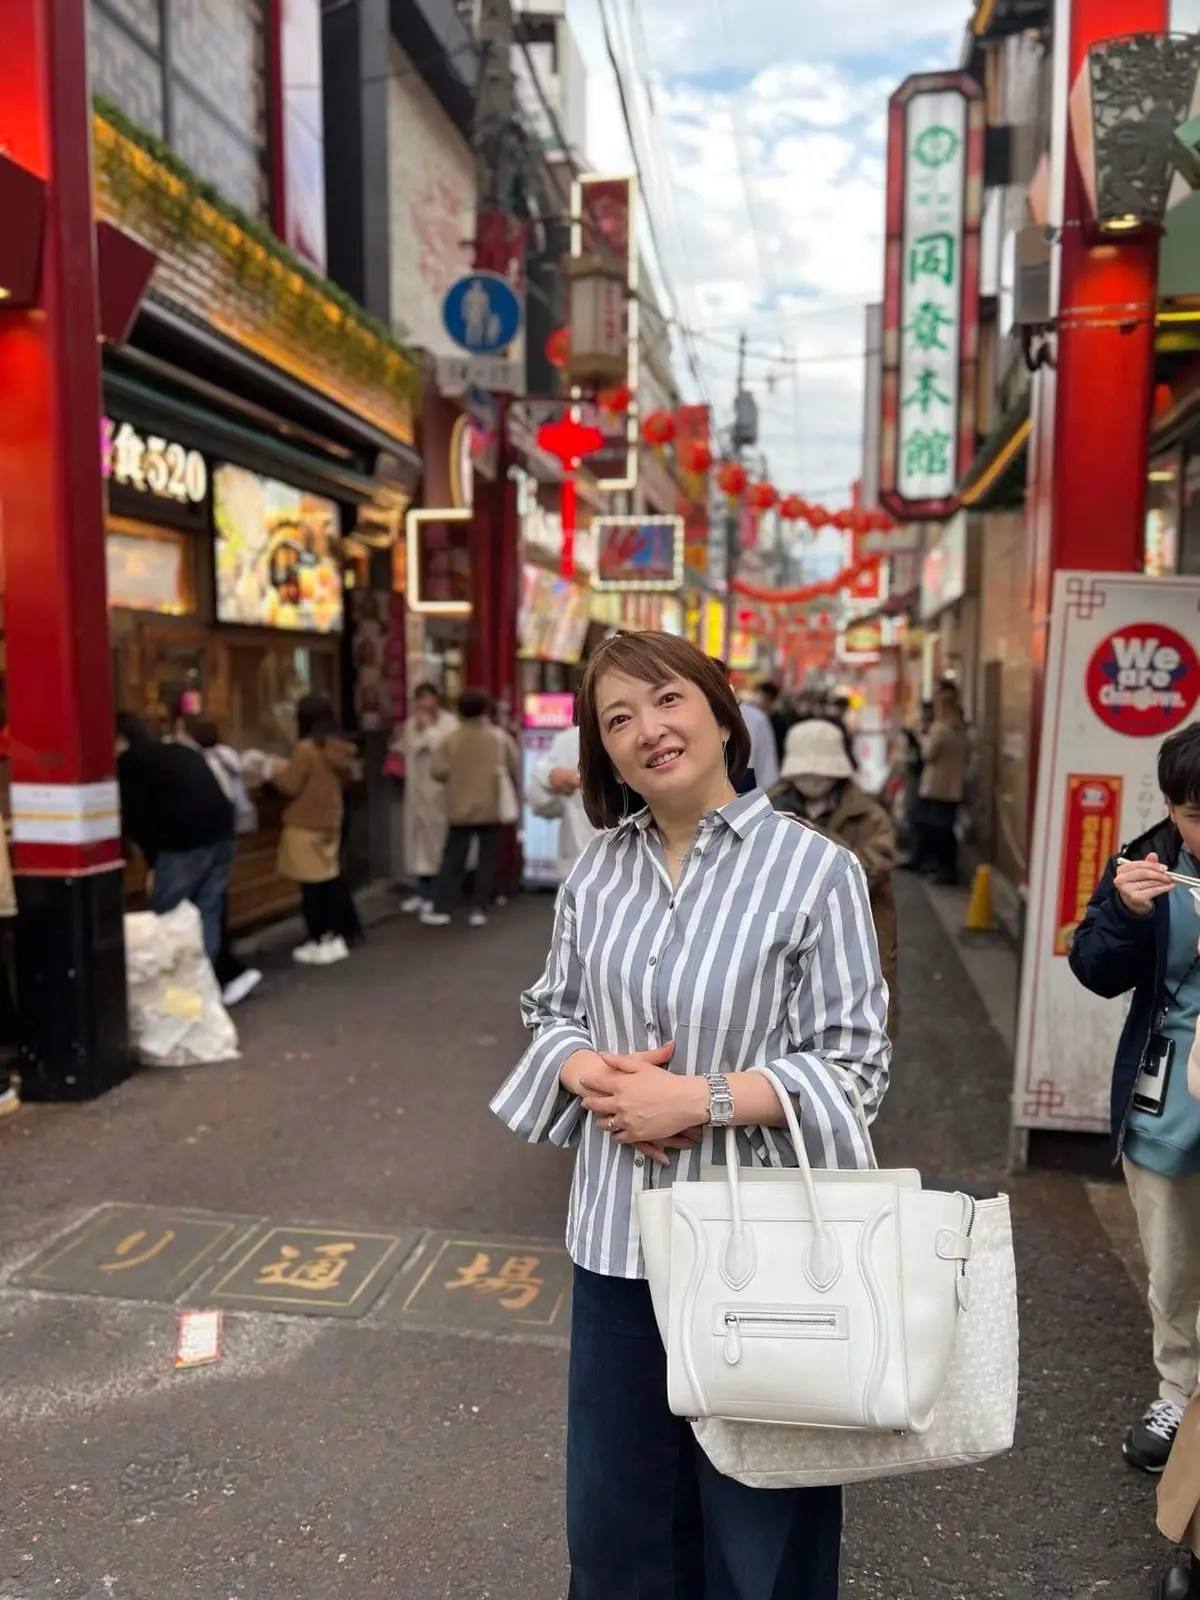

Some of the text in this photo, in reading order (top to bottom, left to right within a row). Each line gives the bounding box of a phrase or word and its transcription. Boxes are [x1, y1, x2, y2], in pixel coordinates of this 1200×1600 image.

[101, 416, 206, 502] 食520
[1111, 637, 1180, 671] We
[1118, 669, 1171, 689] are
